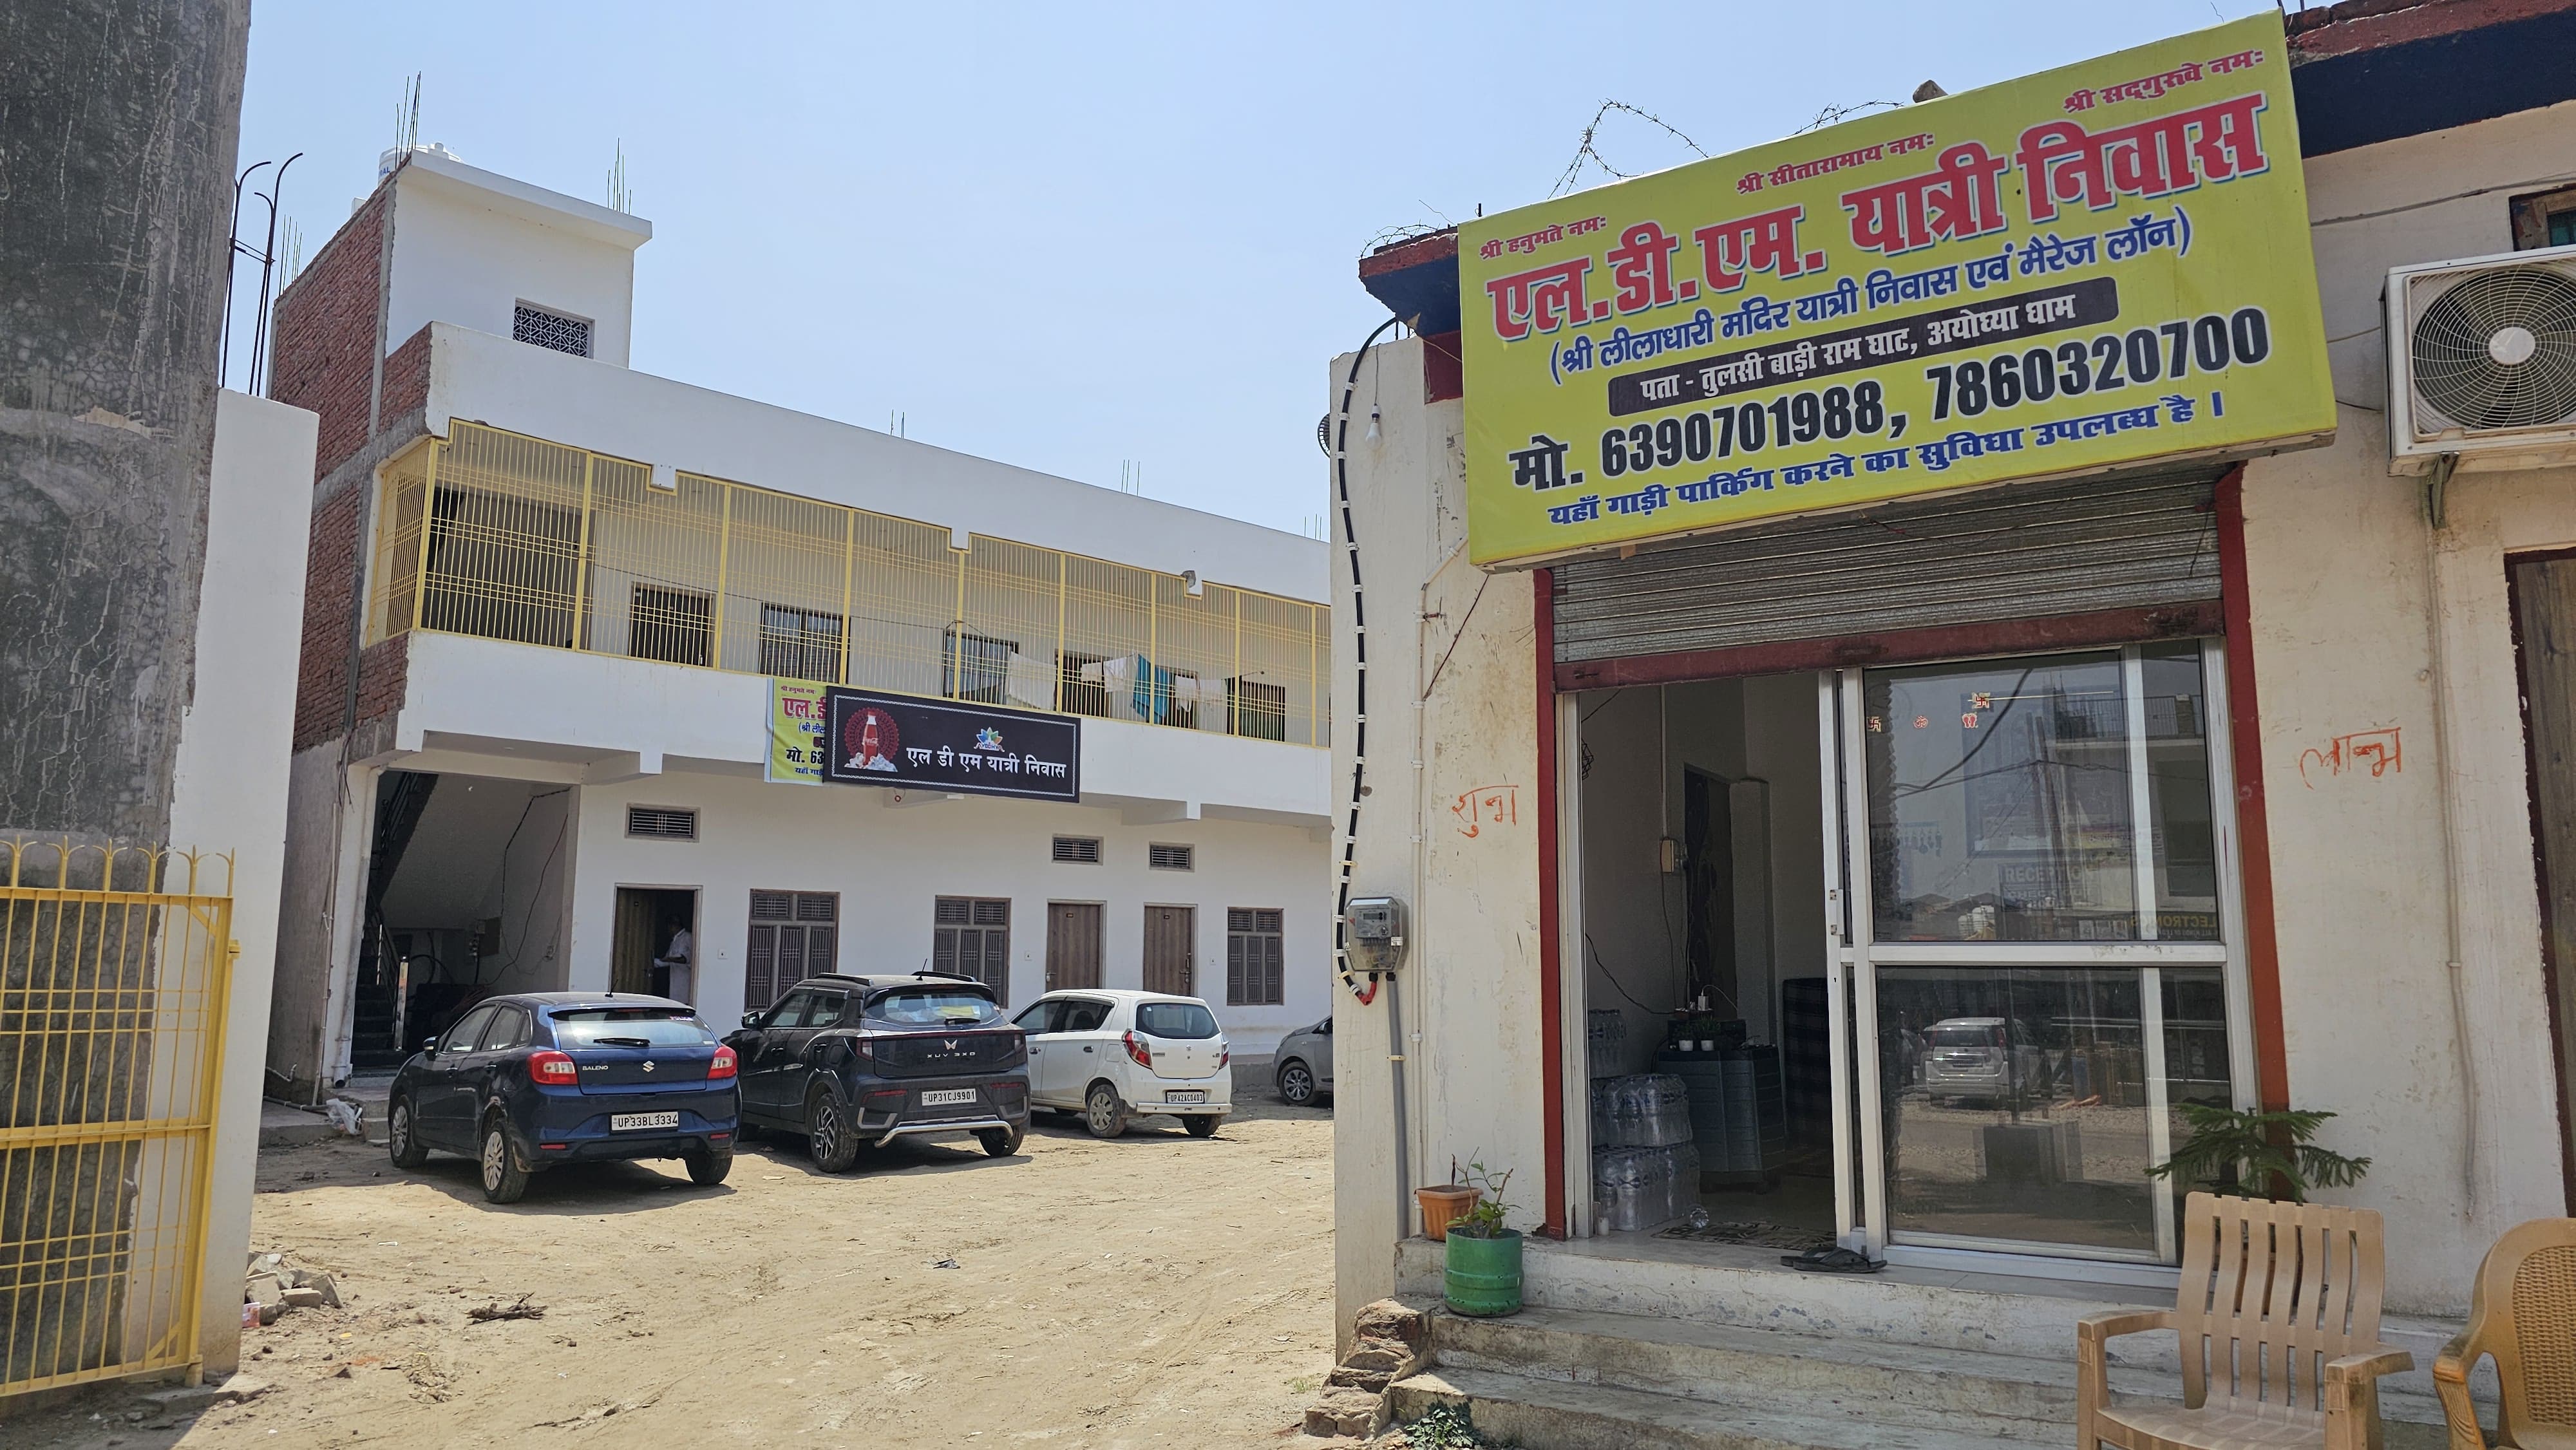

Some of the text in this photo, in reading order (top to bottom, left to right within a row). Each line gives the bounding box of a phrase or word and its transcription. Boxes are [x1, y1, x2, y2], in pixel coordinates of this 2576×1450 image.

[2063, 89, 2096, 113] श्री
[2208, 50, 2264, 74] नमः
[1737, 133, 1935, 194] श्री सीतारामाय नमः
[1841, 142, 2007, 254] यात्री
[2015, 93, 2266, 221] निवास
[1480, 216, 1607, 259] श्री हनुमते नमः
[1600, 308, 1714, 367] लीलाधारी
[1721, 296, 1791, 338] मंदिर
[1796, 278, 1859, 322] यात्री
[1865, 270, 1959, 309] निवास
[1965, 242, 2014, 289] एवं
[2017, 232, 2096, 274] मैरेज
[2105, 206, 2192, 258] लॉन)
[1640, 373, 1680, 401] पता
[1699, 352, 1765, 397] तुलसी
[1767, 341, 1817, 377] बाड़ी
[1821, 337, 1862, 366] राम
[1927, 305, 2019, 346] अयोध्या
[2025, 294, 2076, 325] धाम
[1509, 435, 1584, 490] मो.
[1926, 308, 2269, 420] 7860320700
[1548, 495, 1600, 525] यहाँ
[1605, 484, 1671, 515] गाड़ी
[1780, 453, 1855, 486] करने
[1861, 447, 1909, 473] का
[1916, 428, 2025, 471] सुविधा
[2031, 404, 2159, 447] उपलब्ध
[2159, 394, 2195, 423] है
[906, 745, 1067, 778] एल डी एम यात्री निवास
[618, 1114, 677, 1127] UP33BL3334
[928, 1091, 975, 1102] UP31CJ9901
